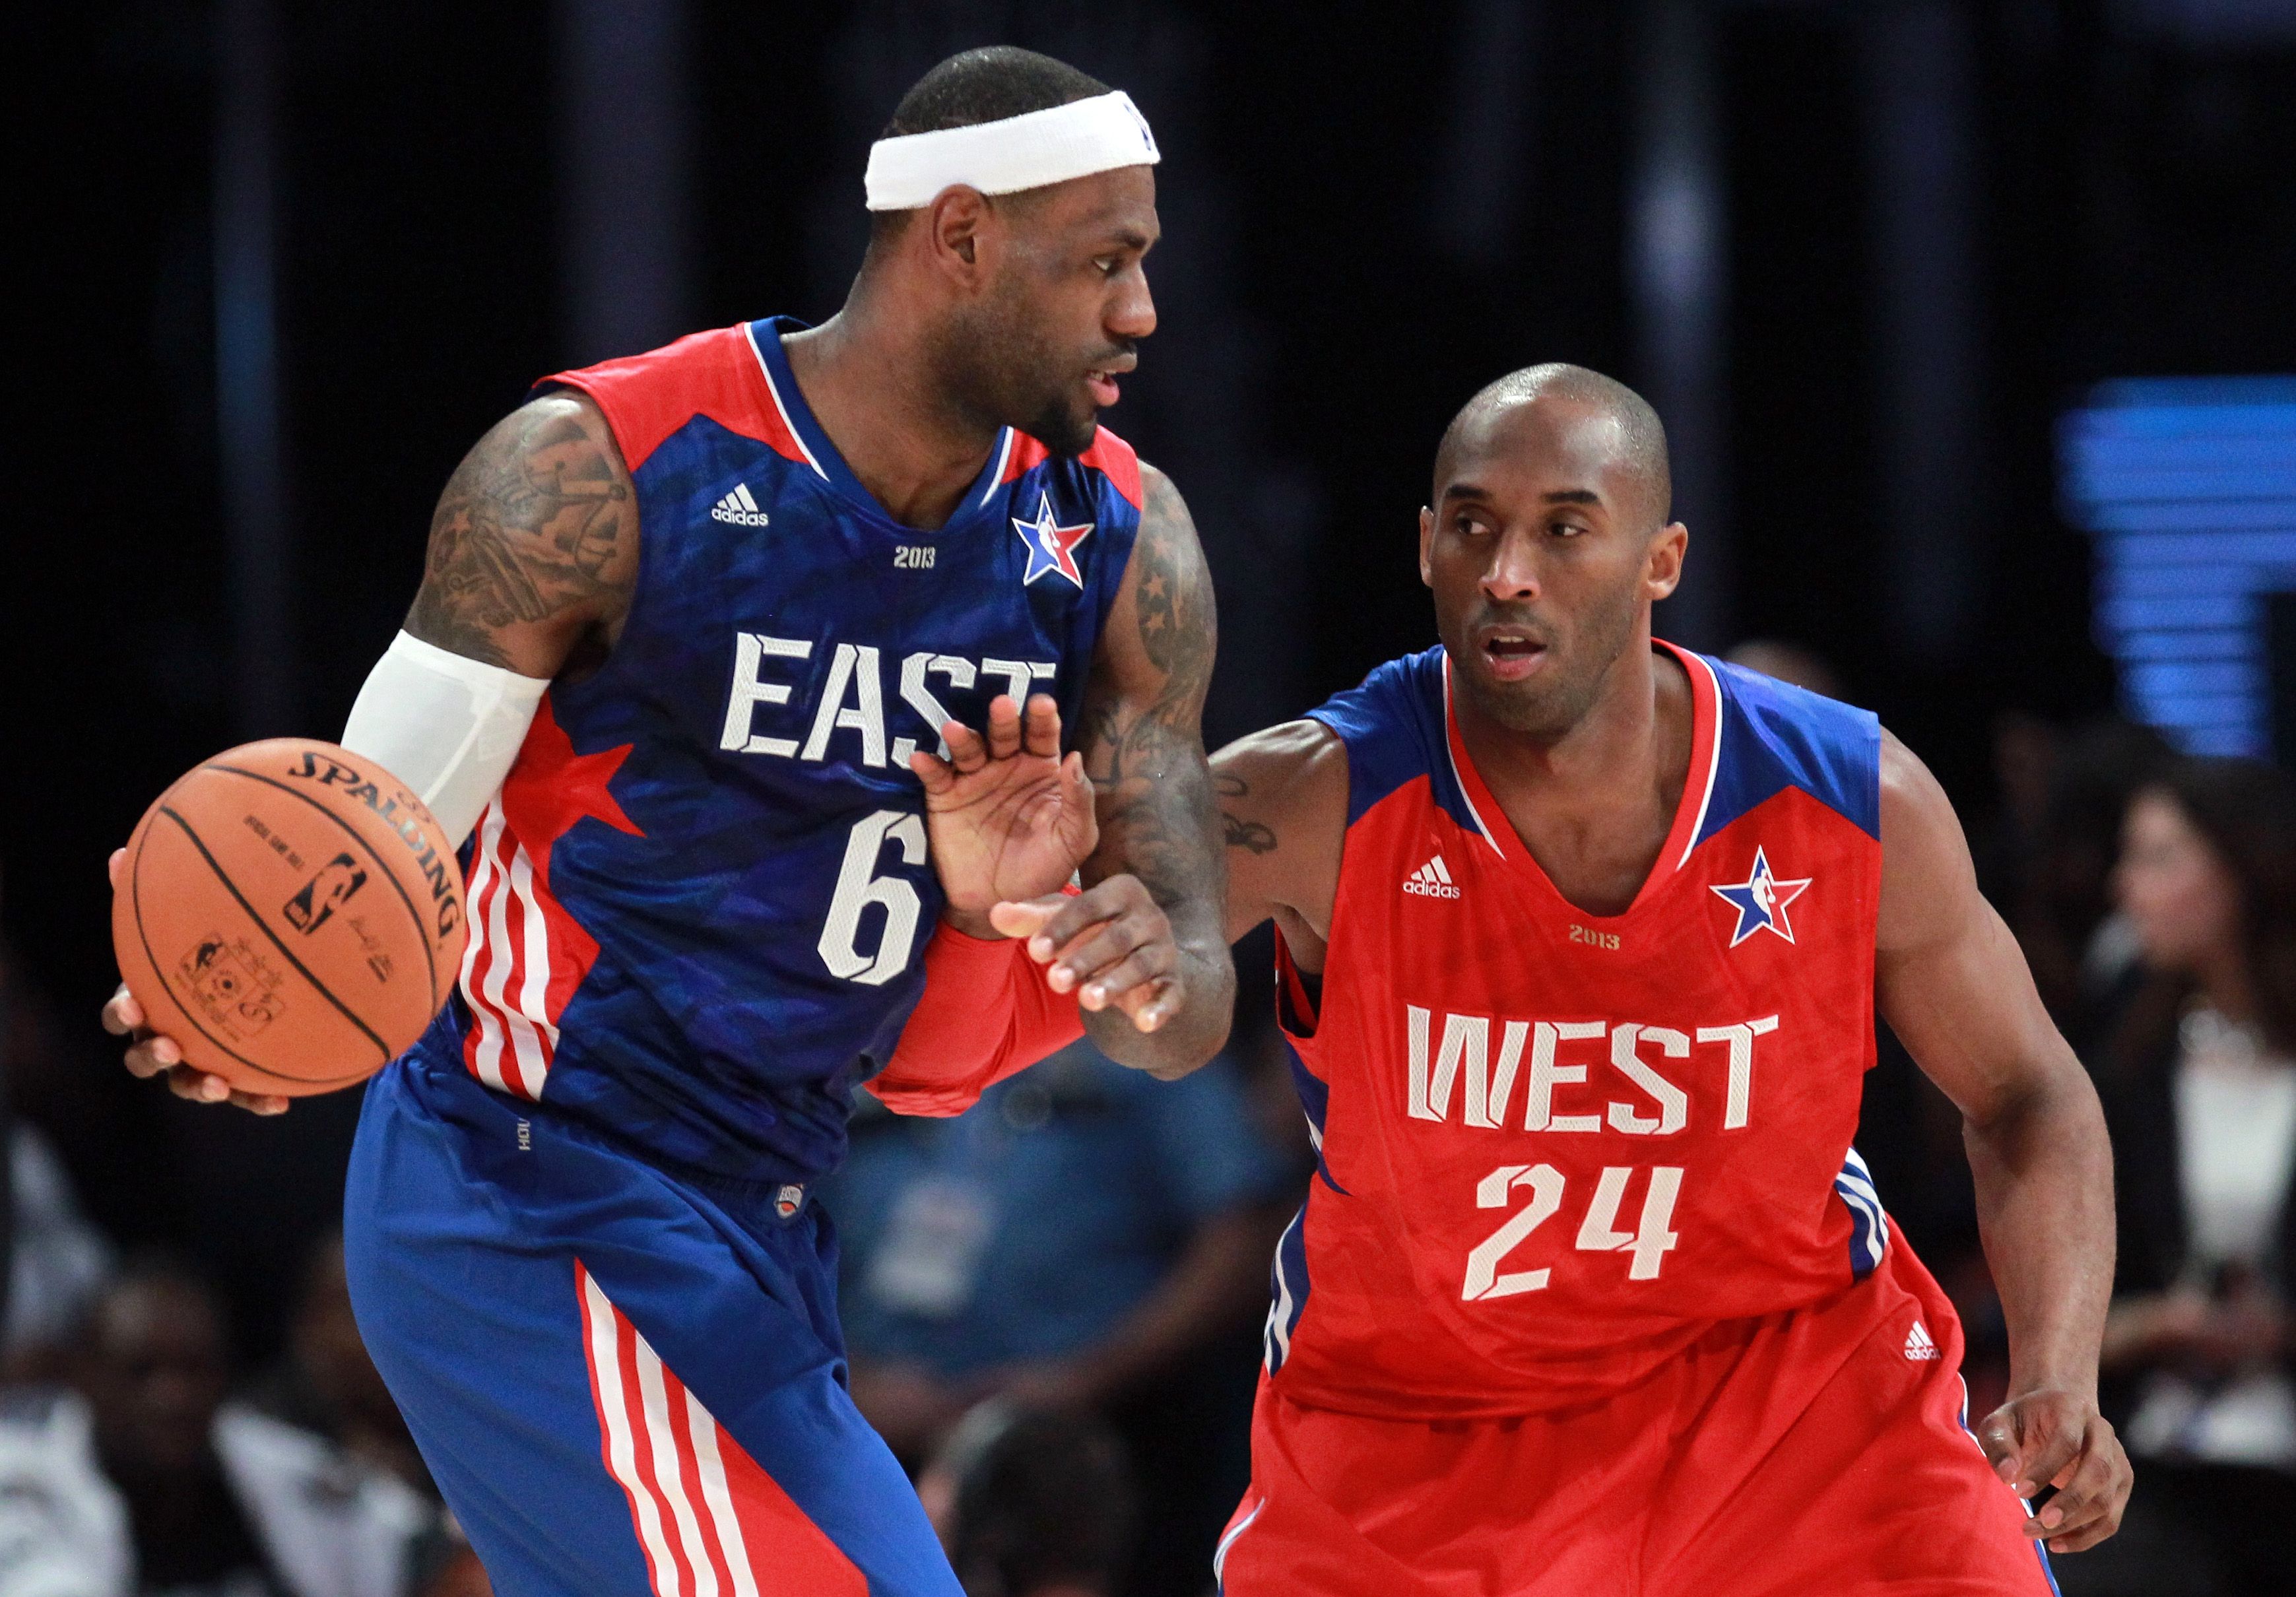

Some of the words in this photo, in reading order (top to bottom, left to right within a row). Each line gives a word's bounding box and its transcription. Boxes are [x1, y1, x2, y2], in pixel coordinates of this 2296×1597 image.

[711, 506, 769, 527] adidas
[894, 545, 936, 568] 2013
[720, 632, 1056, 769] EAST
[288, 752, 461, 938] SPALDING
[817, 809, 927, 985] 6
[1402, 878, 1460, 899] adidas
[1569, 924, 1620, 950] 2013
[1407, 1003, 1779, 1136] WEST
[1461, 1163, 1685, 1301] 24
